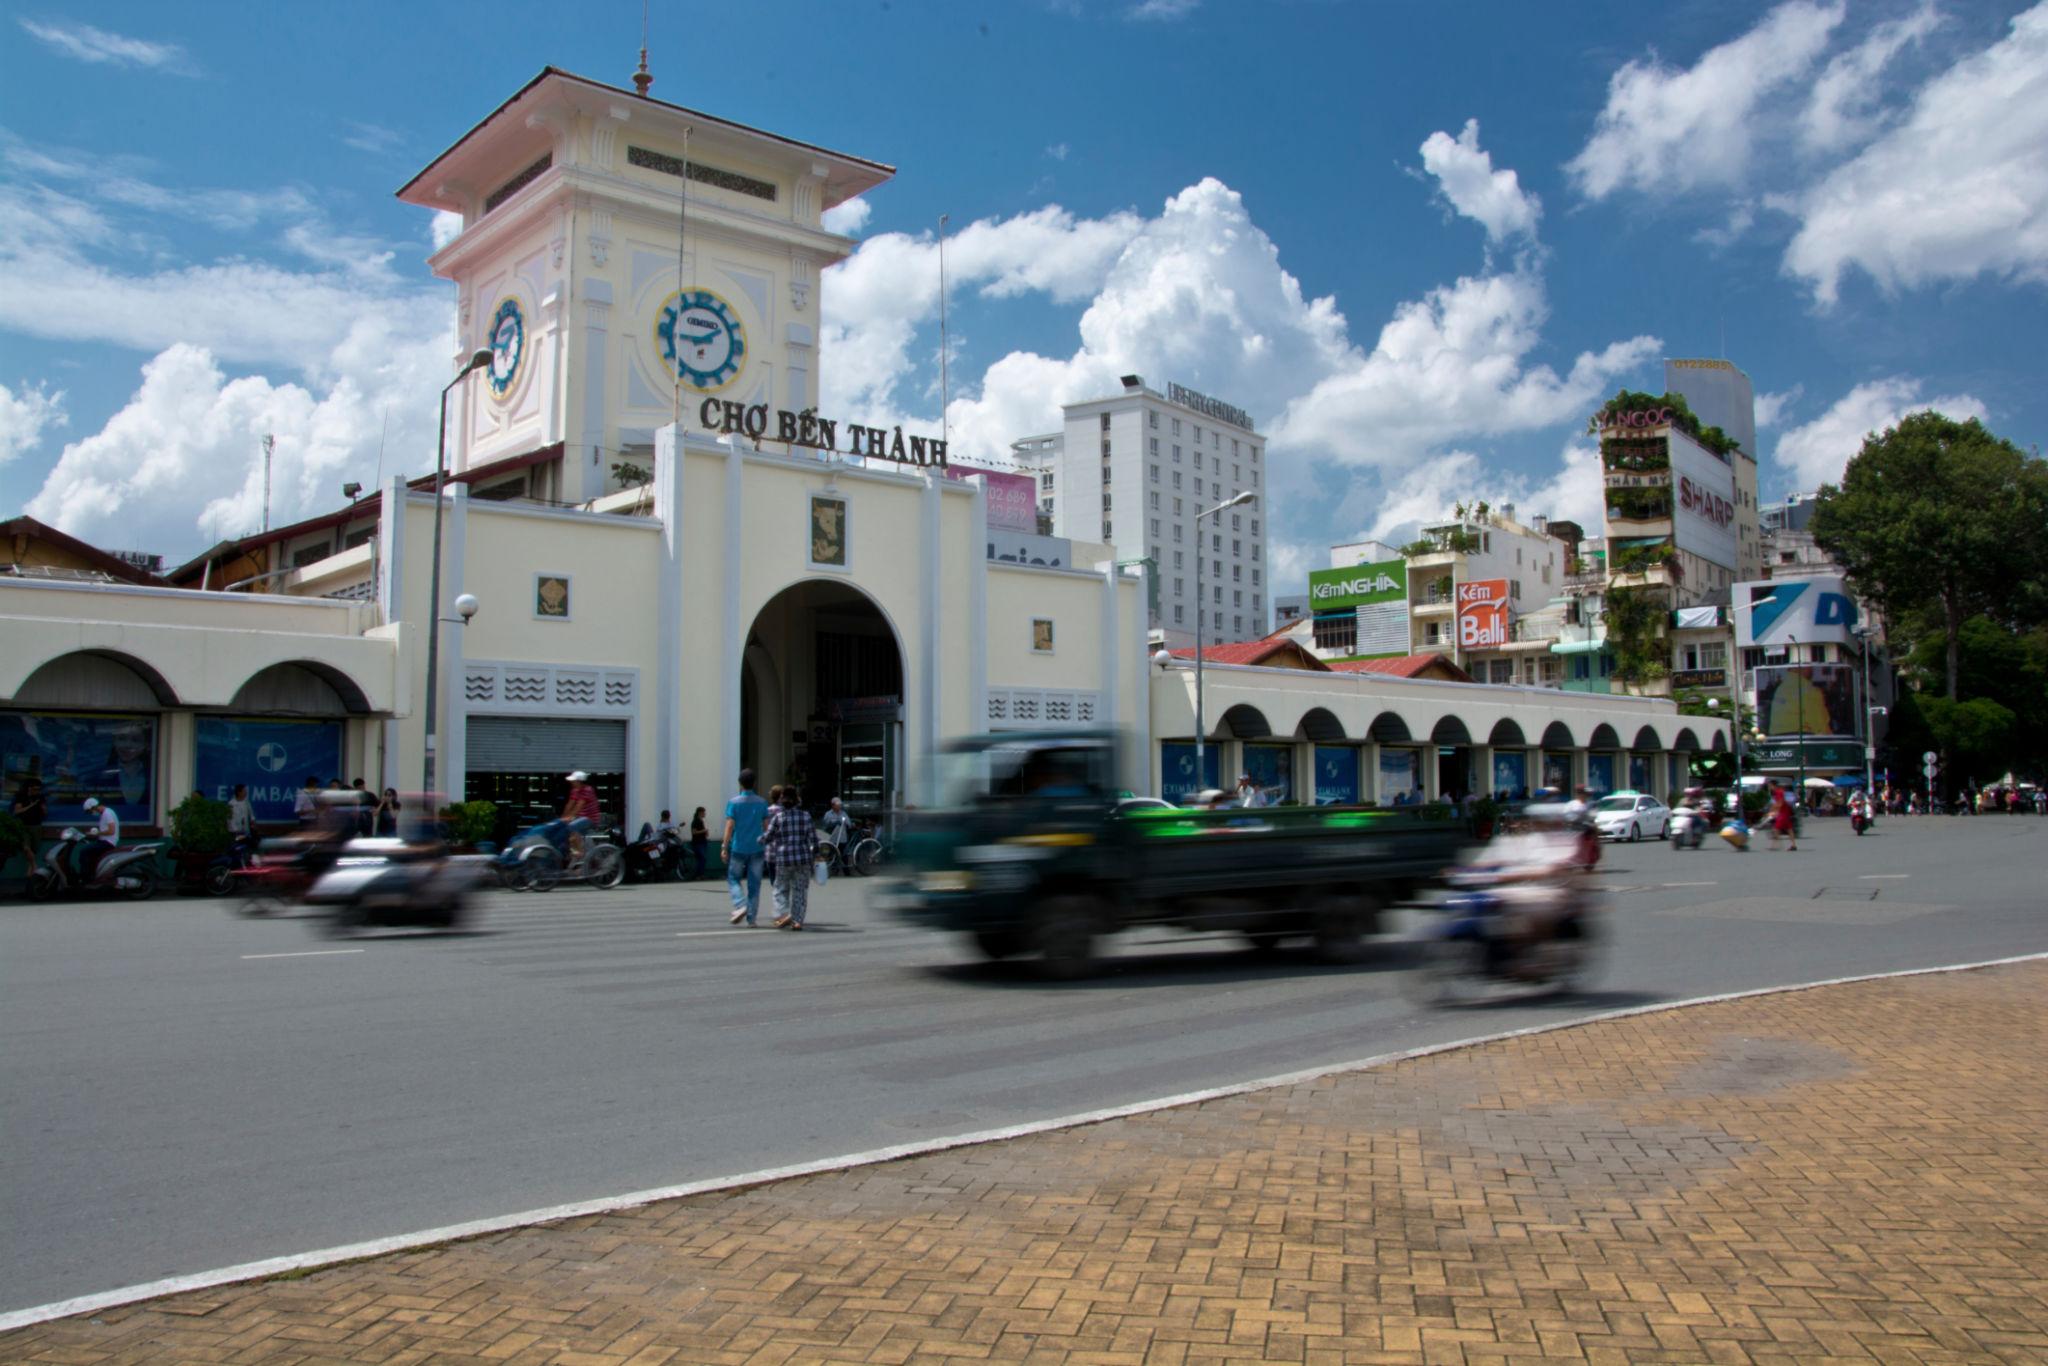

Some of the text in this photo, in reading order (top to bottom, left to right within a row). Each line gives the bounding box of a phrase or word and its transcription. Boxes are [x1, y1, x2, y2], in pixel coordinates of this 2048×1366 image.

[700, 397, 948, 470] CHỢ BẾN THÀNH
[1680, 476, 1734, 528] SHARP
[1770, 750, 1793, 758] LONG
